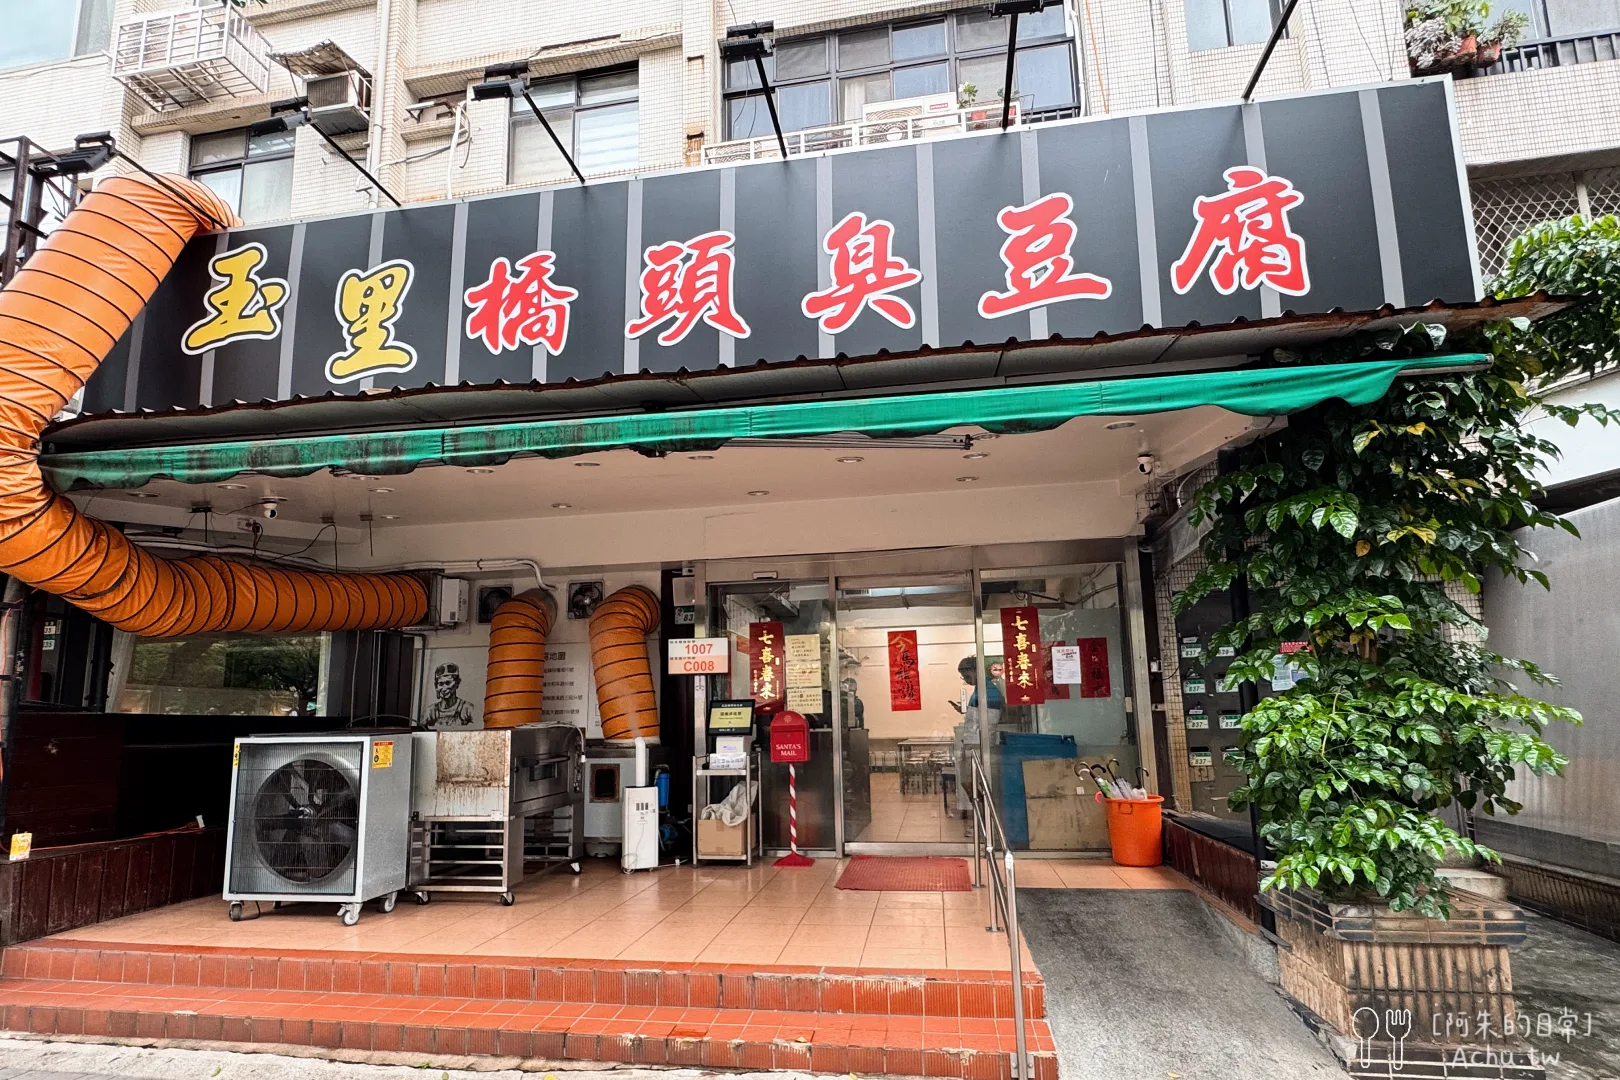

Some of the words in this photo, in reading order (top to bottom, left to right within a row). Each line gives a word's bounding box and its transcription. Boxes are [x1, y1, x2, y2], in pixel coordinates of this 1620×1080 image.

[181, 166, 1311, 384] 玉里橋頭臭豆腐
[683, 660, 715, 672] C008
[685, 643, 713, 655] 1007
[758, 630, 775, 700] 七喜春來
[1011, 615, 1034, 689] 七喜春來
